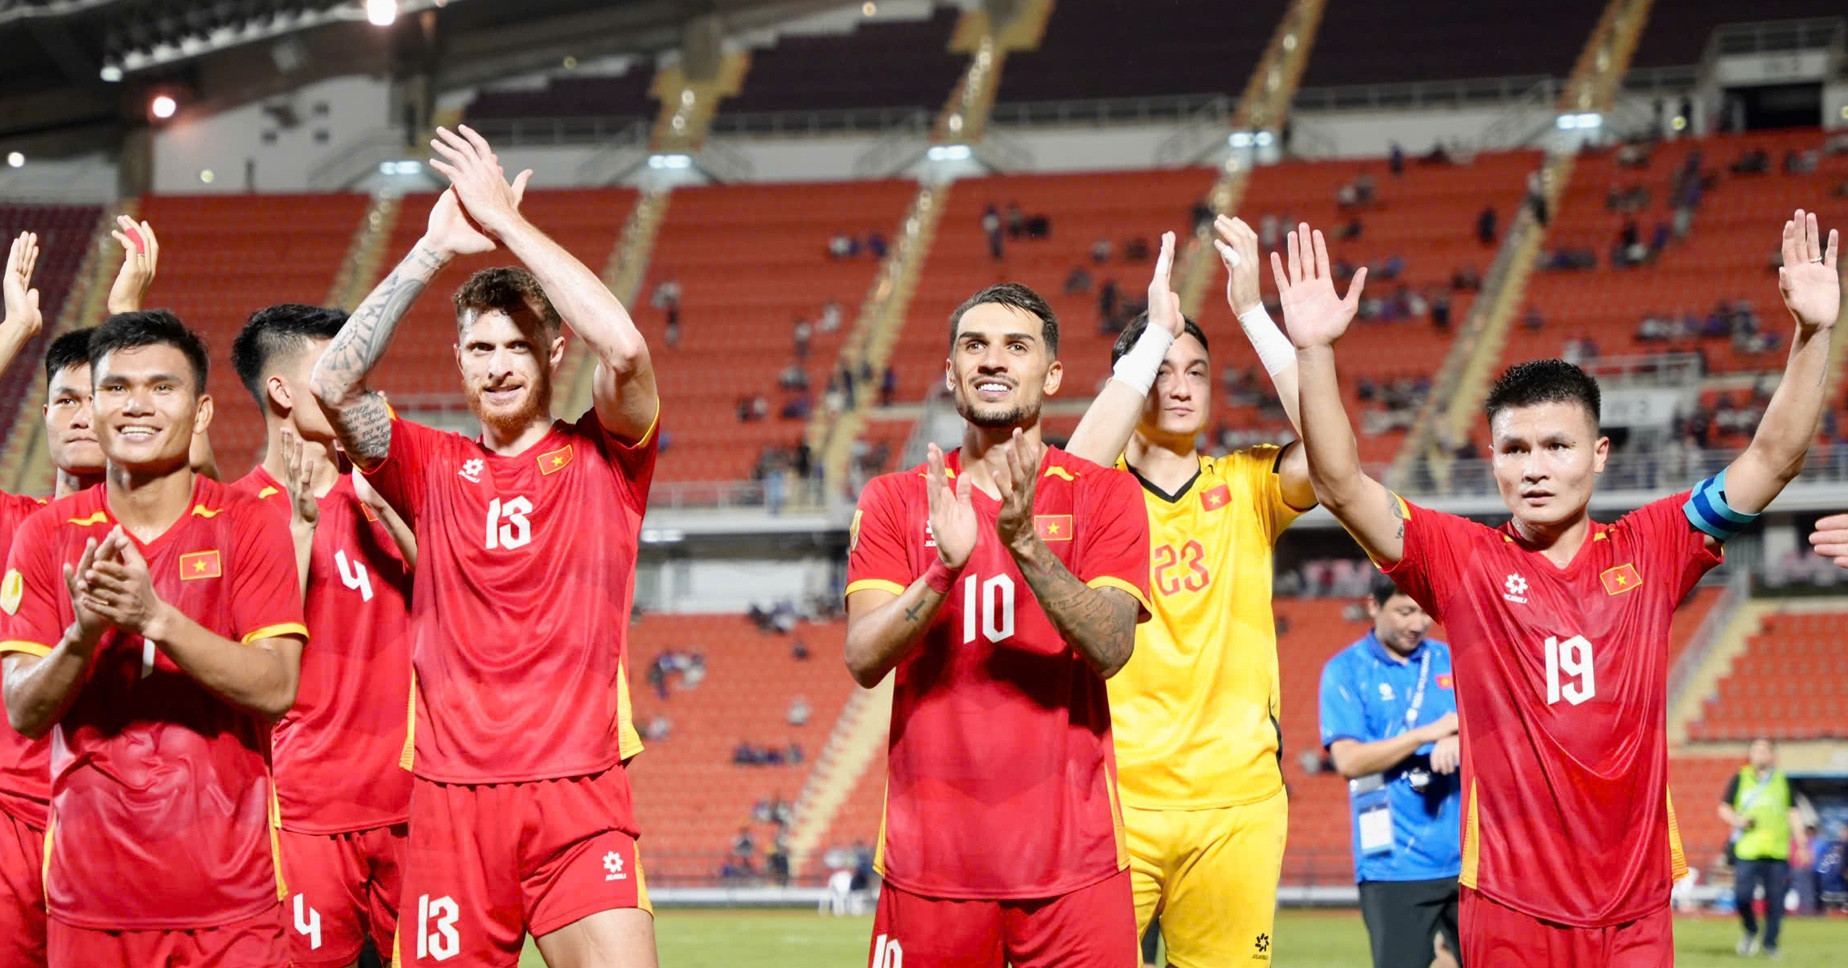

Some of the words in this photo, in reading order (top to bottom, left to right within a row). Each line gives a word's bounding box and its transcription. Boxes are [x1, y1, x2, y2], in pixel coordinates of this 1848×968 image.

[485, 495, 533, 551] 13
[334, 549, 374, 602] 4
[1154, 539, 1210, 596] 23
[963, 573, 1015, 644] 10
[1544, 635, 1596, 706] 19
[293, 893, 322, 950] 4
[416, 894, 460, 961] 13
